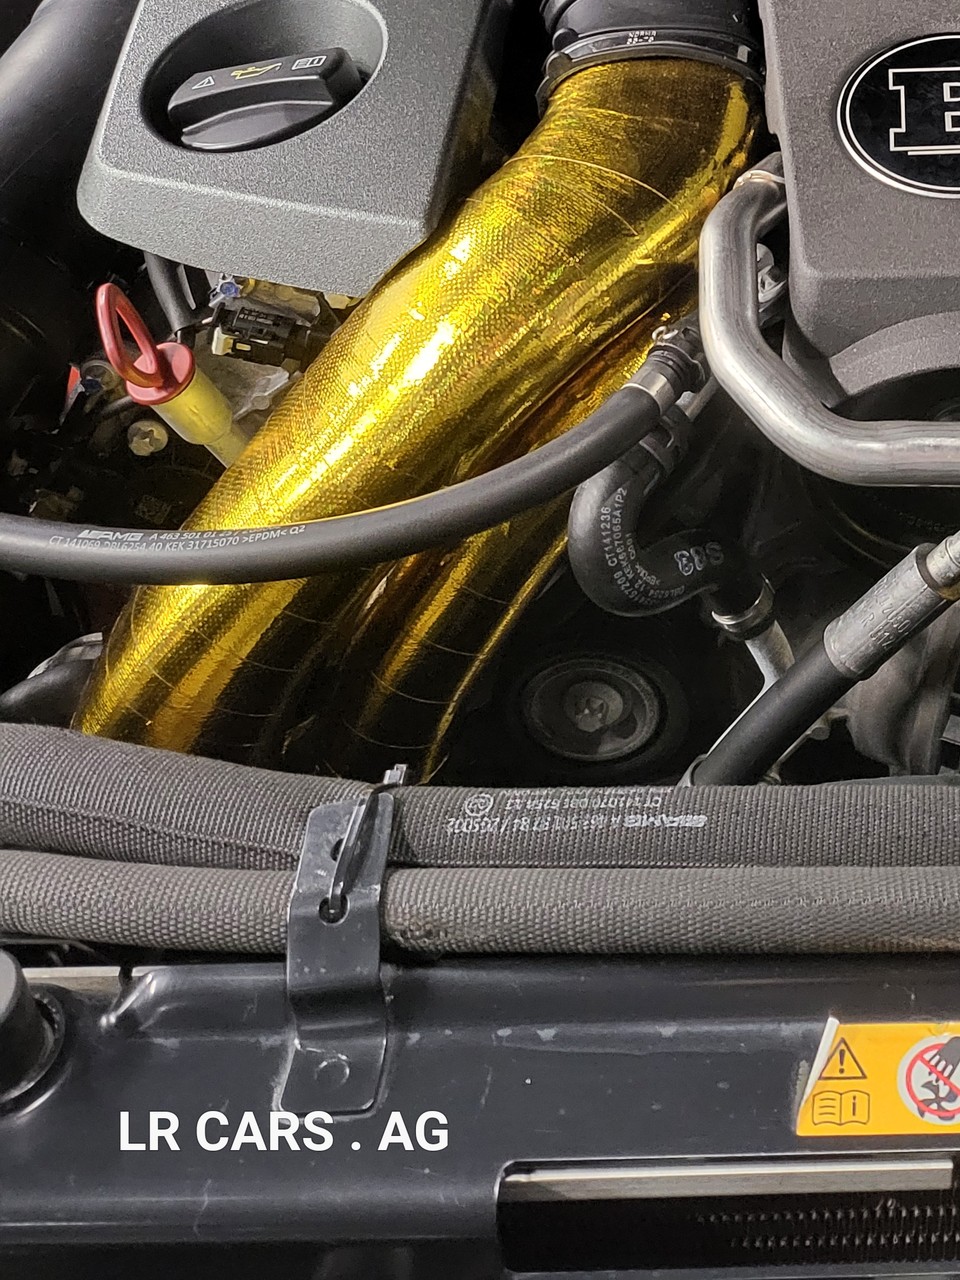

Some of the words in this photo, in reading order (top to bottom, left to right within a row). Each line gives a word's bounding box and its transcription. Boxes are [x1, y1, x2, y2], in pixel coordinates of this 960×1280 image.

[159, 532, 180, 540] 463
[164, 541, 185, 552] KEK
[186, 536, 240, 551] 31715070
[289, 525, 306, 534] Q2
[601, 506, 617, 567] CT141236
